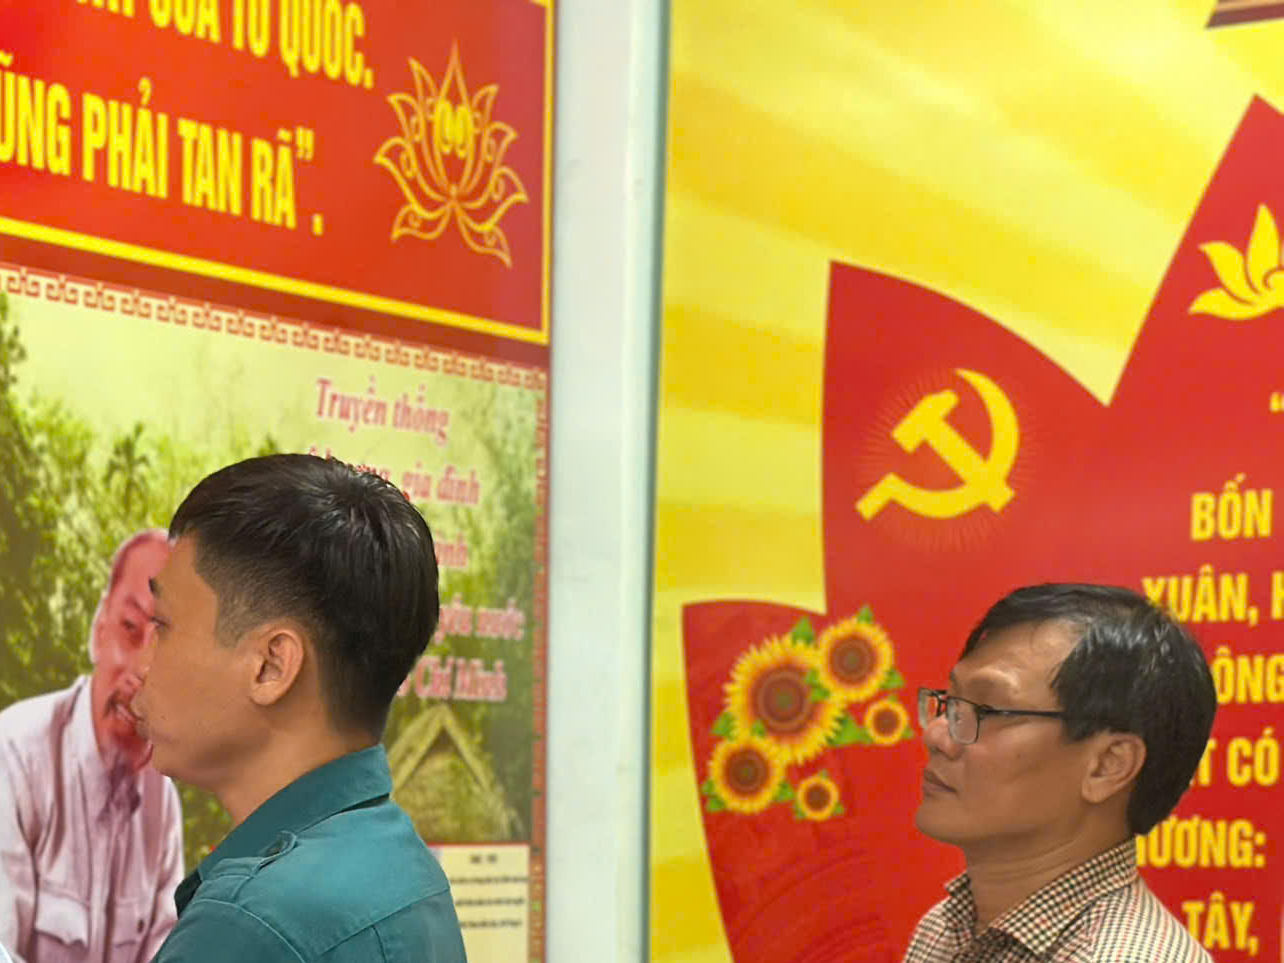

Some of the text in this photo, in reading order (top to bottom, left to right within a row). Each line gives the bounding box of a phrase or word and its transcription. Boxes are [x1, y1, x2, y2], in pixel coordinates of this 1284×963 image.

[83, 77, 168, 199] PHẢI
[178, 118, 242, 217] TAN
[1190, 473, 1273, 542] BỐN
[1212, 644, 1284, 704] ÔNG
[1226, 726, 1279, 786] CÓ
[1136, 814, 1266, 868] ƯƠNG:
[1182, 889, 1259, 957] TÂY,
